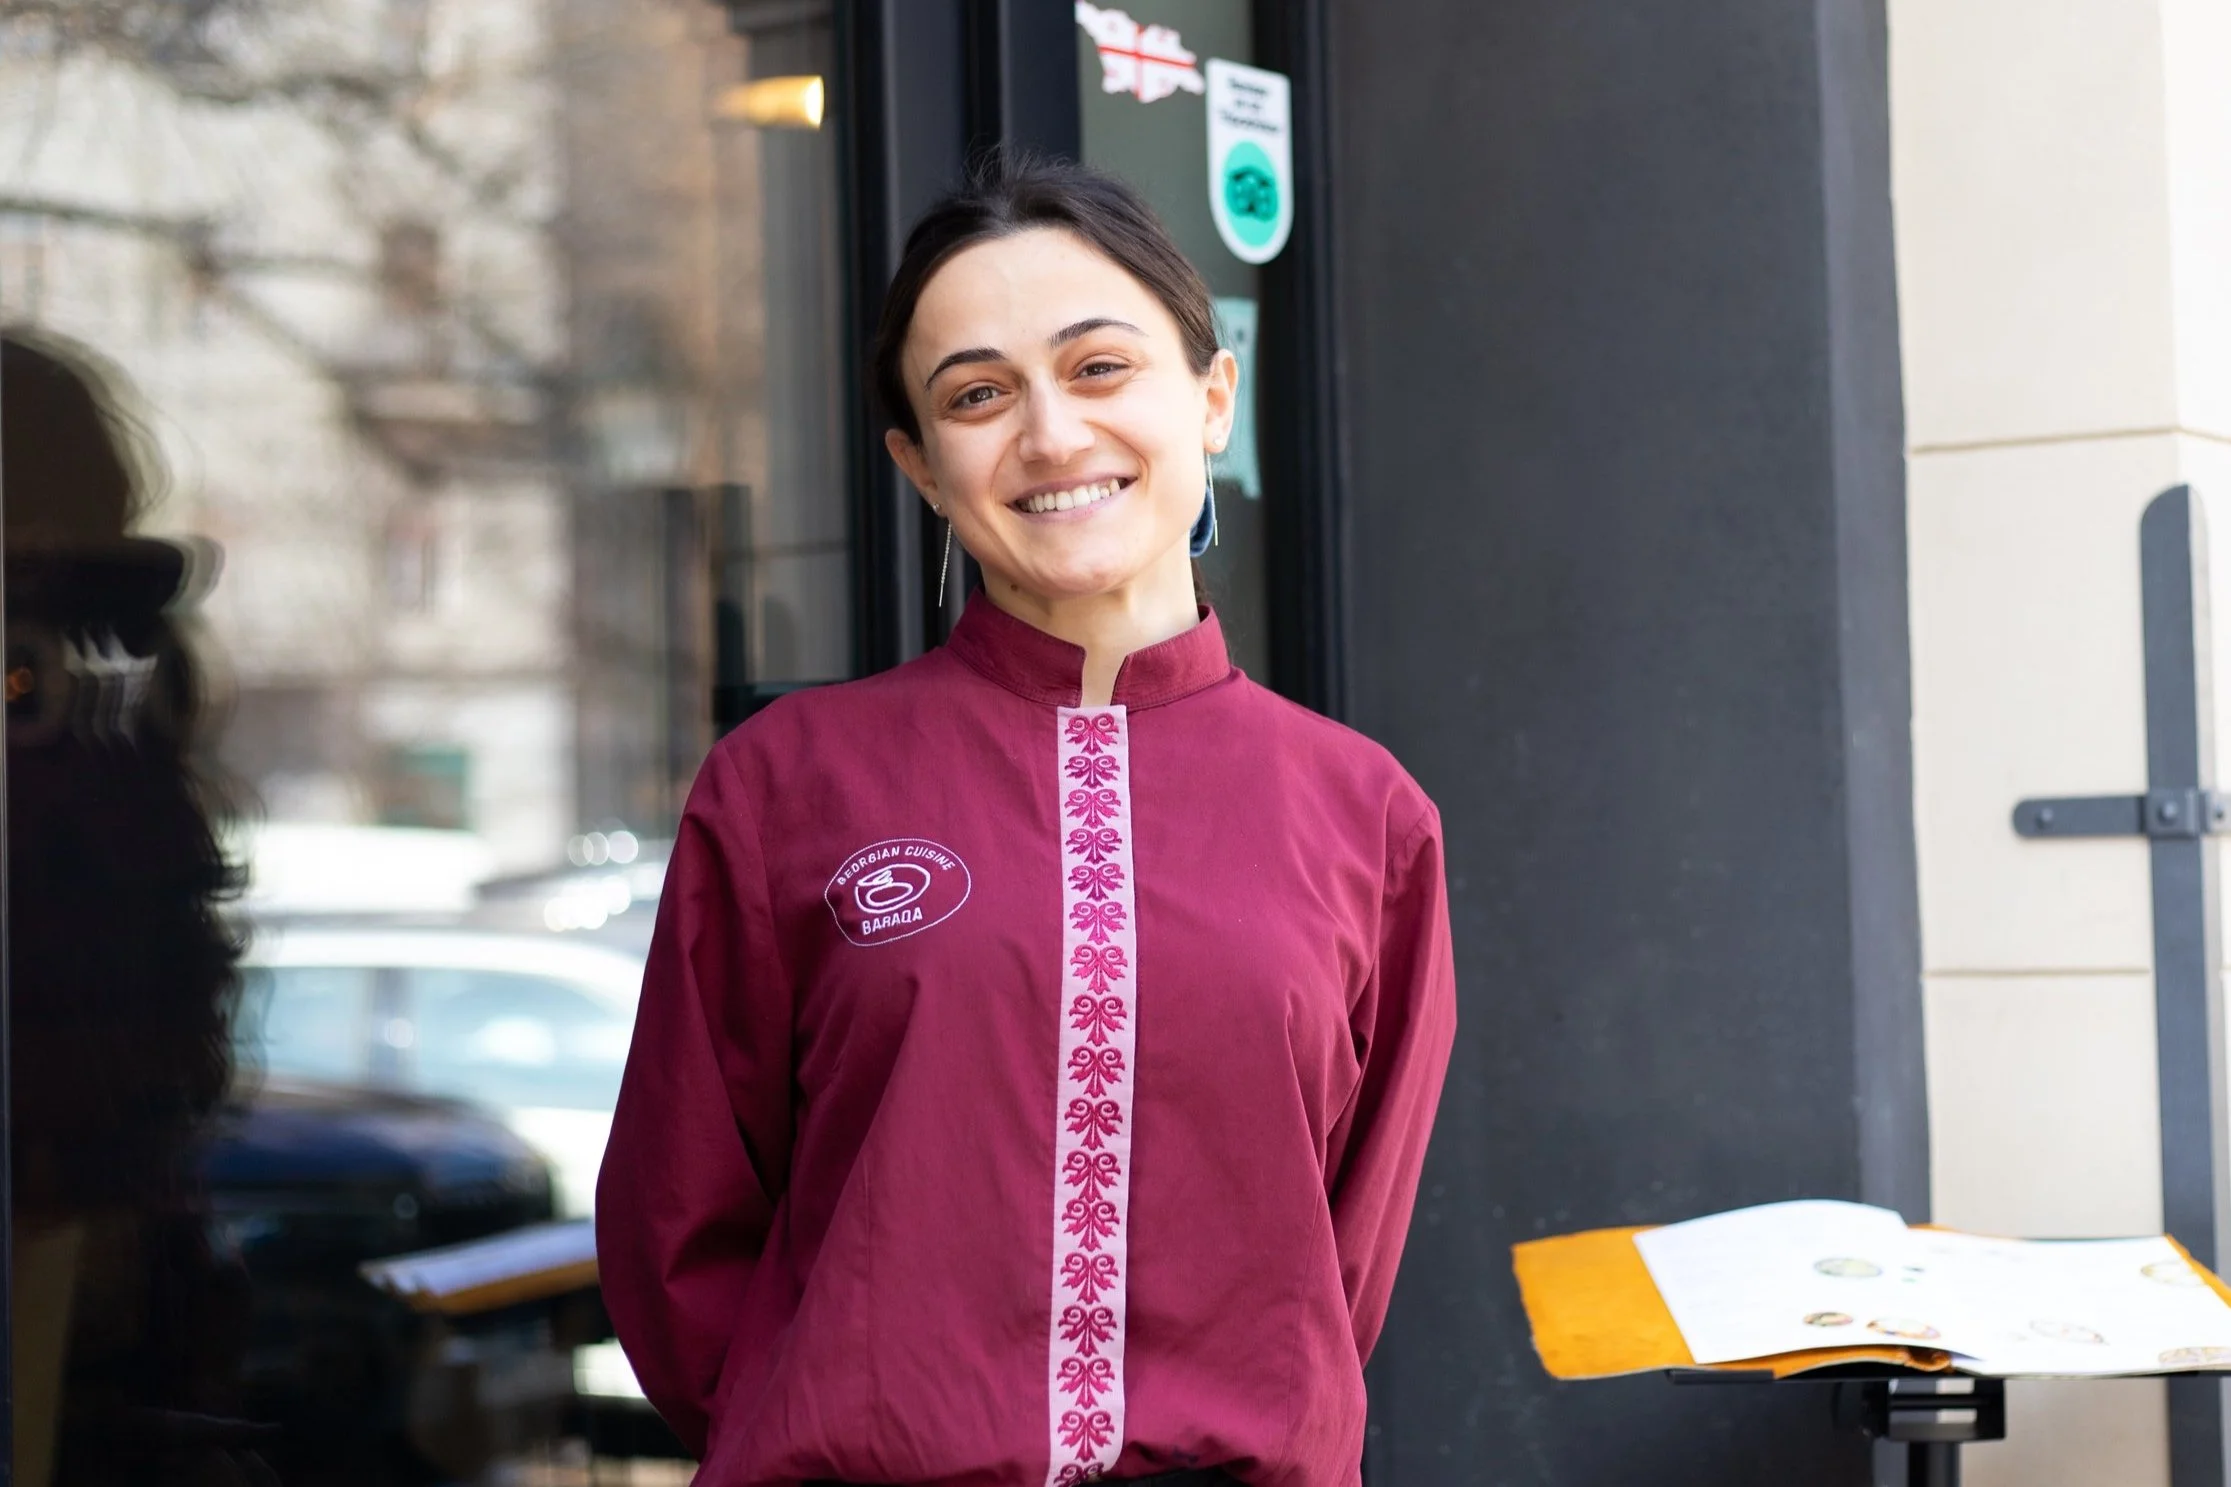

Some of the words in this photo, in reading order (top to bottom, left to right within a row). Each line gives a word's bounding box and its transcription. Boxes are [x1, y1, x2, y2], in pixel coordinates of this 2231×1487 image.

[837, 846, 900, 885] GEORGIAN
[904, 846, 956, 871] CUISINE
[862, 907, 923, 935] BARAQA
